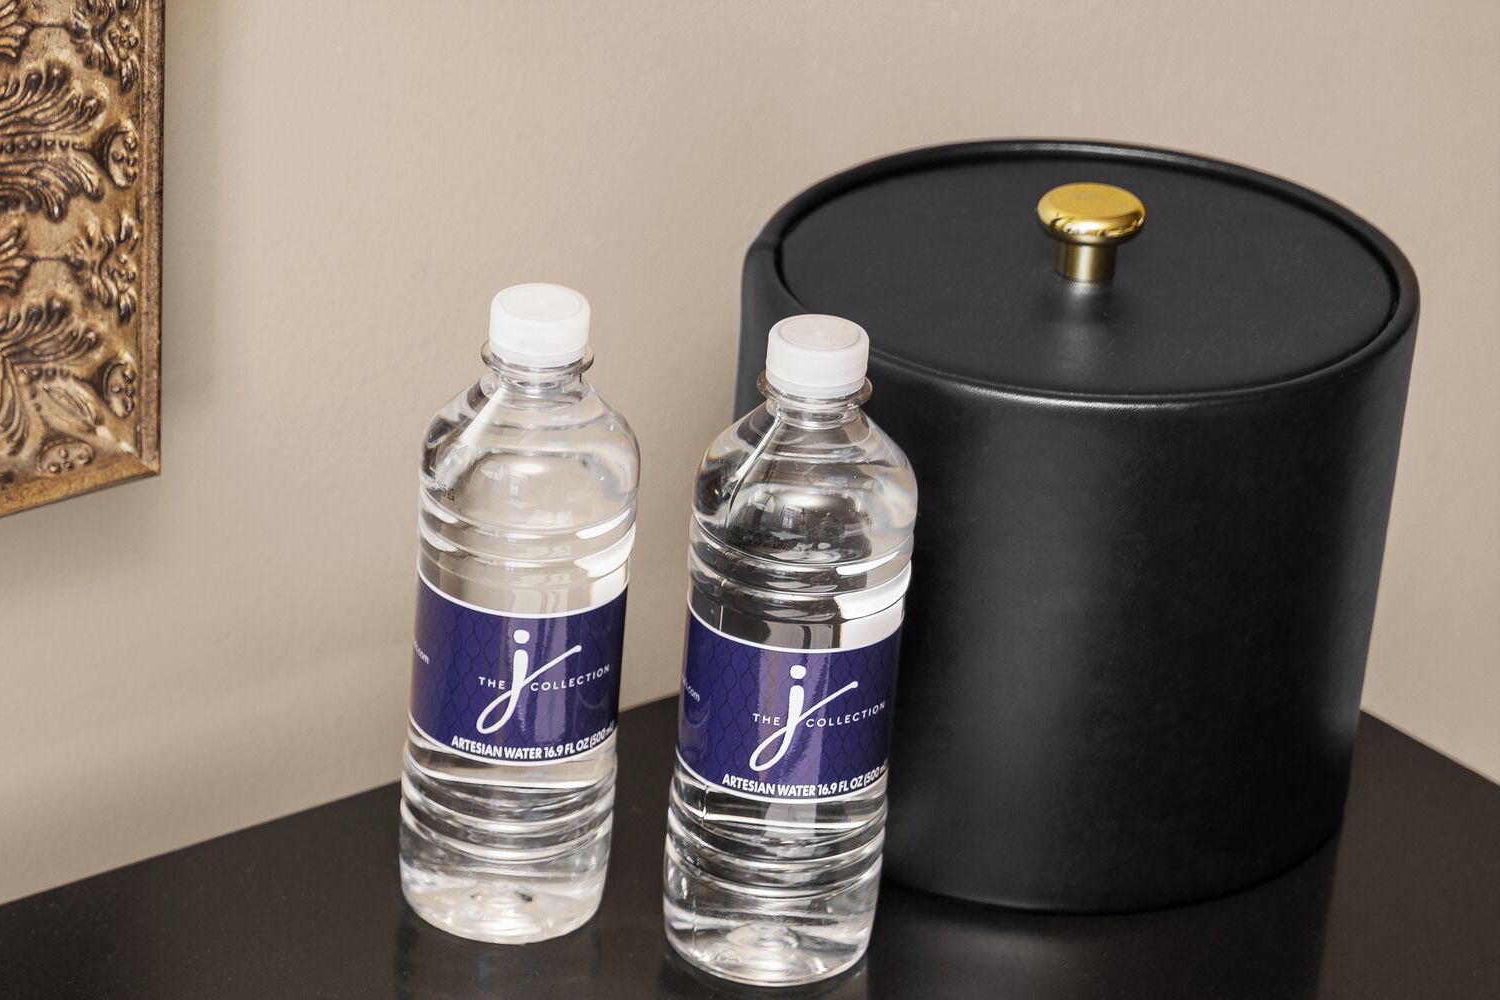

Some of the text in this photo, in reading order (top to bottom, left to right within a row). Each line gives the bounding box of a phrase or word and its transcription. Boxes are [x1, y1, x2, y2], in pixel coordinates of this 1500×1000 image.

[478, 676, 506, 690] THE
[530, 663, 610, 692] COLLECTION
[752, 713, 781, 726] THE
[805, 700, 886, 728] COLLECTION
[451, 735, 502, 758] ARTESIAN
[503, 746, 542, 759] WATER
[543, 744, 563, 758] 16.9
[564, 742, 576, 755] FL
[575, 736, 590, 752] OZ
[721, 773, 776, 795] ARTESIAN
[777, 781, 817, 797] WATER
[817, 780, 838, 795] 16.9
[838, 779, 850, 793] FL
[850, 774, 864, 790] OZ
